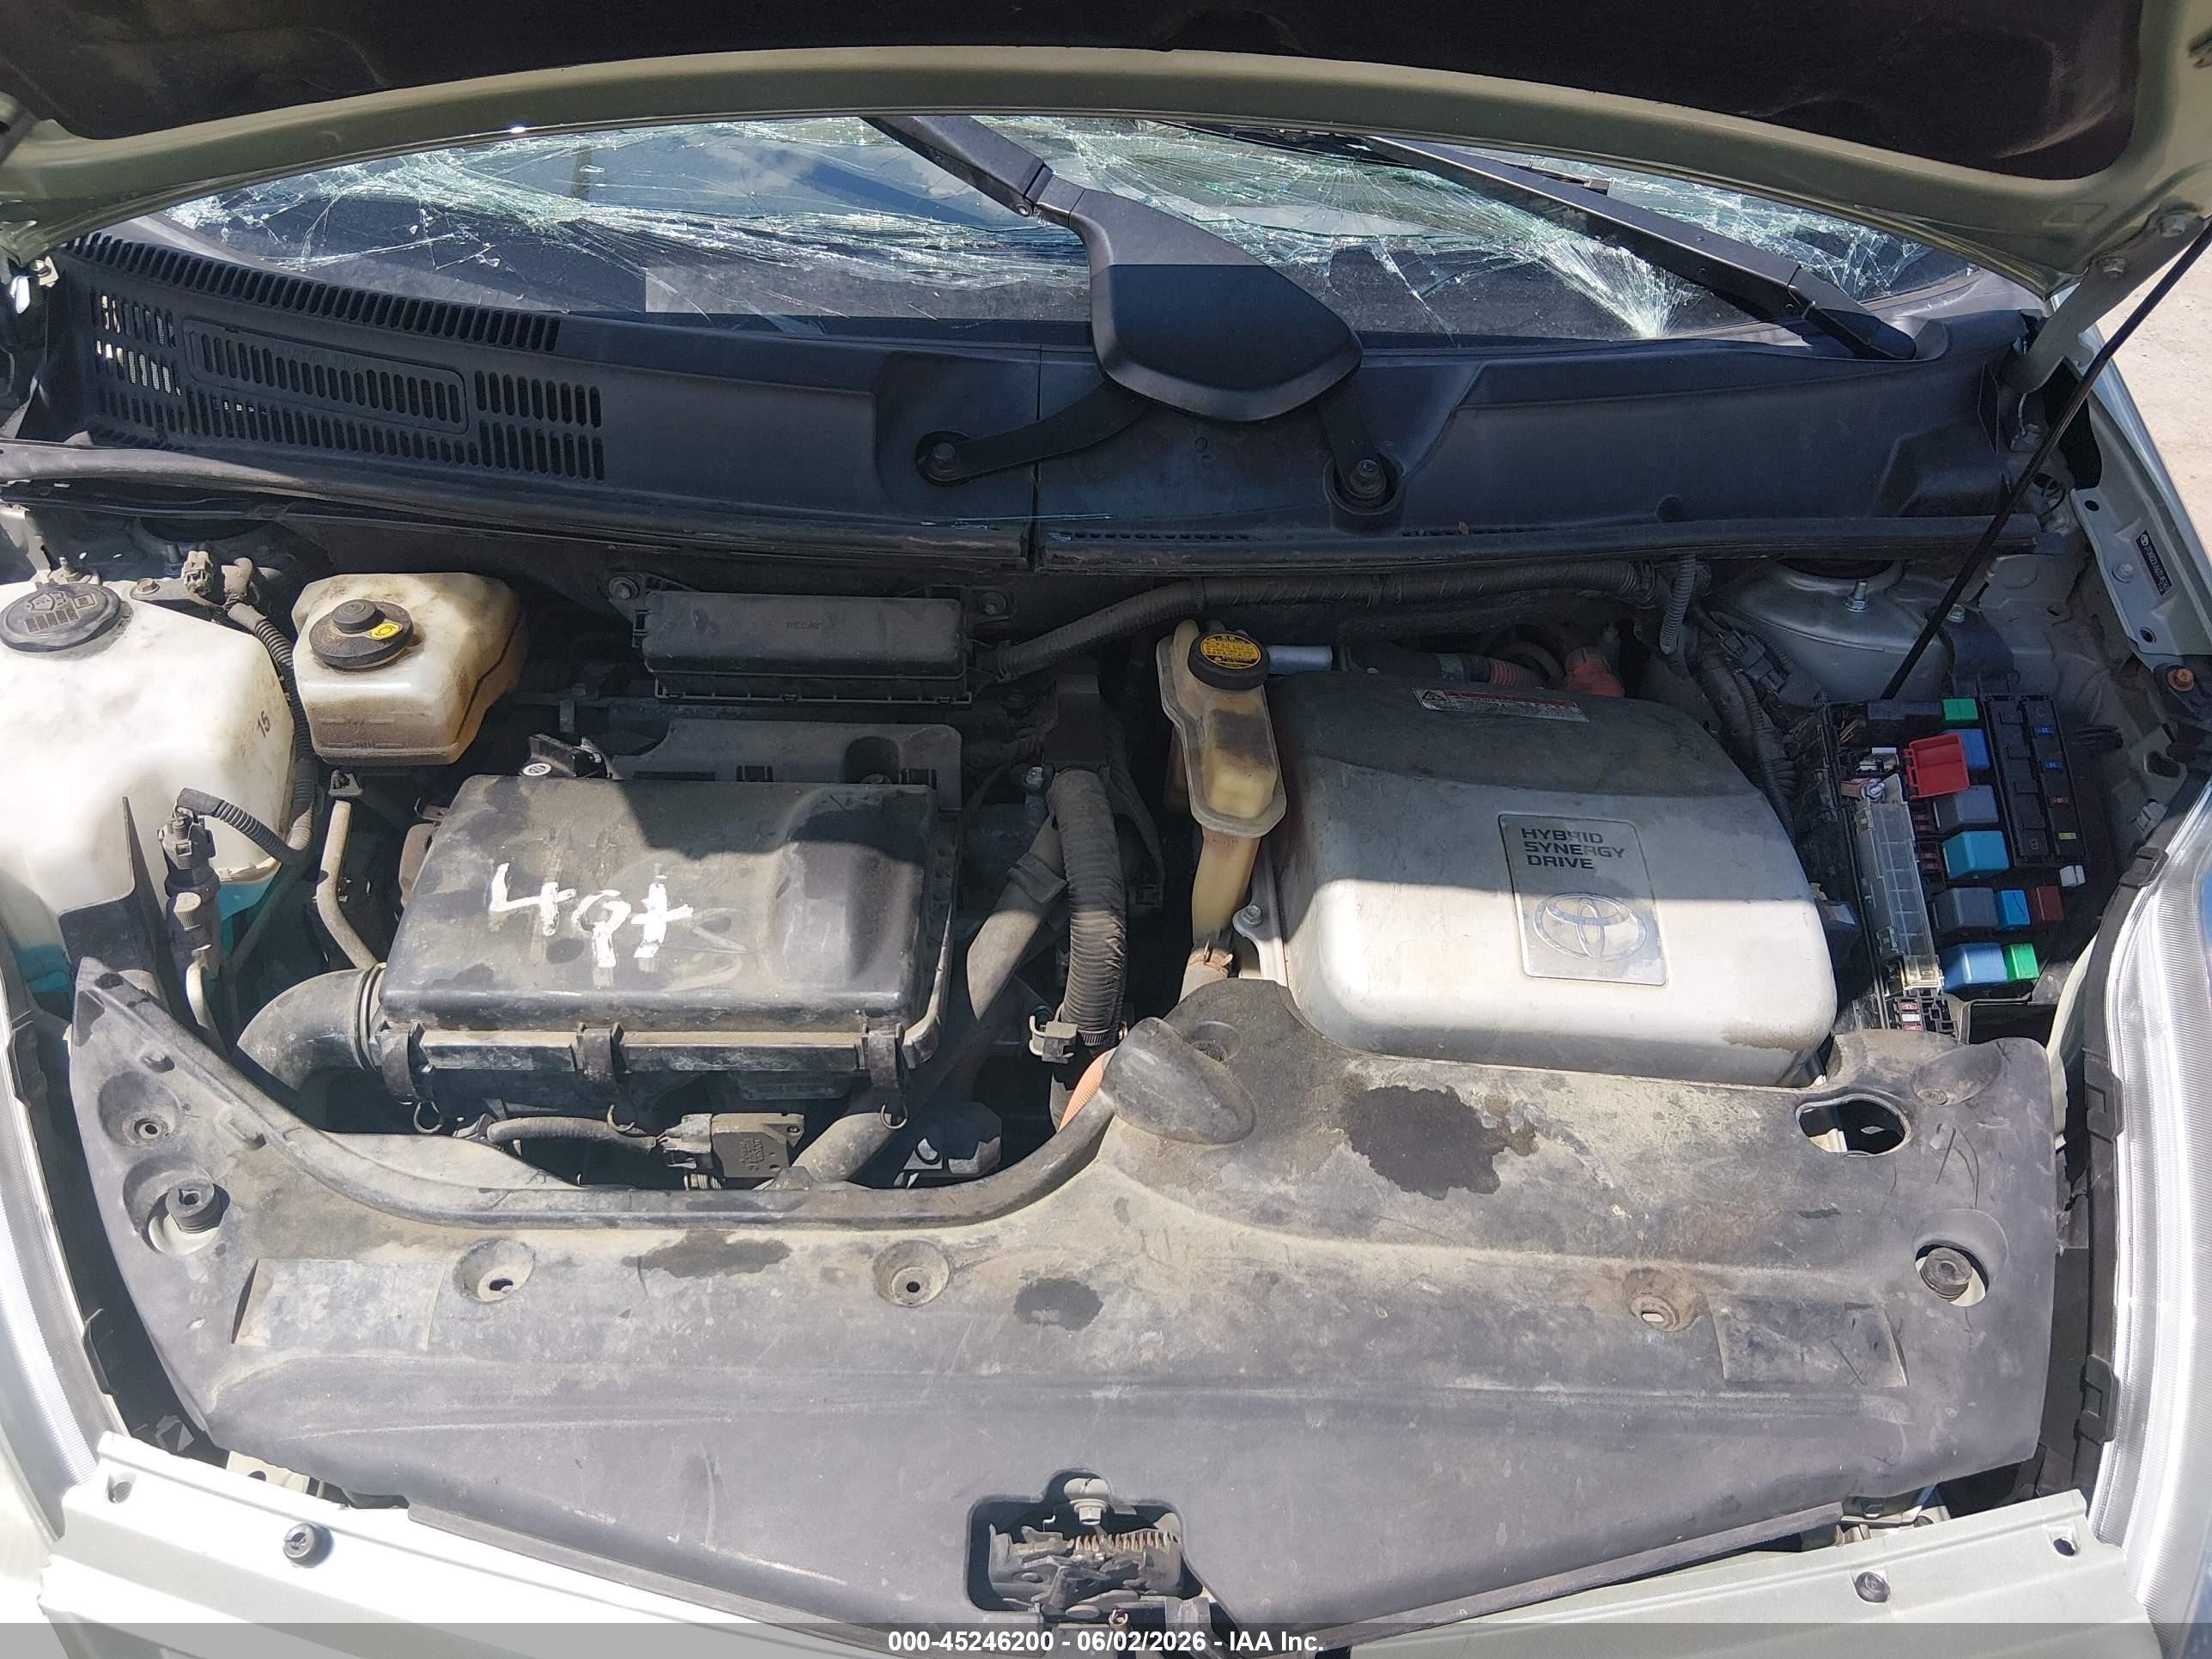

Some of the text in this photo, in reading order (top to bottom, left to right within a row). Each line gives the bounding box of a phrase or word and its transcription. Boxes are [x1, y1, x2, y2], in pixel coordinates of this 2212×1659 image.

[257, 710, 270, 738] 15
[1521, 828, 1603, 844] HYBRID
[1524, 842, 1625, 858] SYNERGY
[1527, 854, 1595, 869] DRIVE
